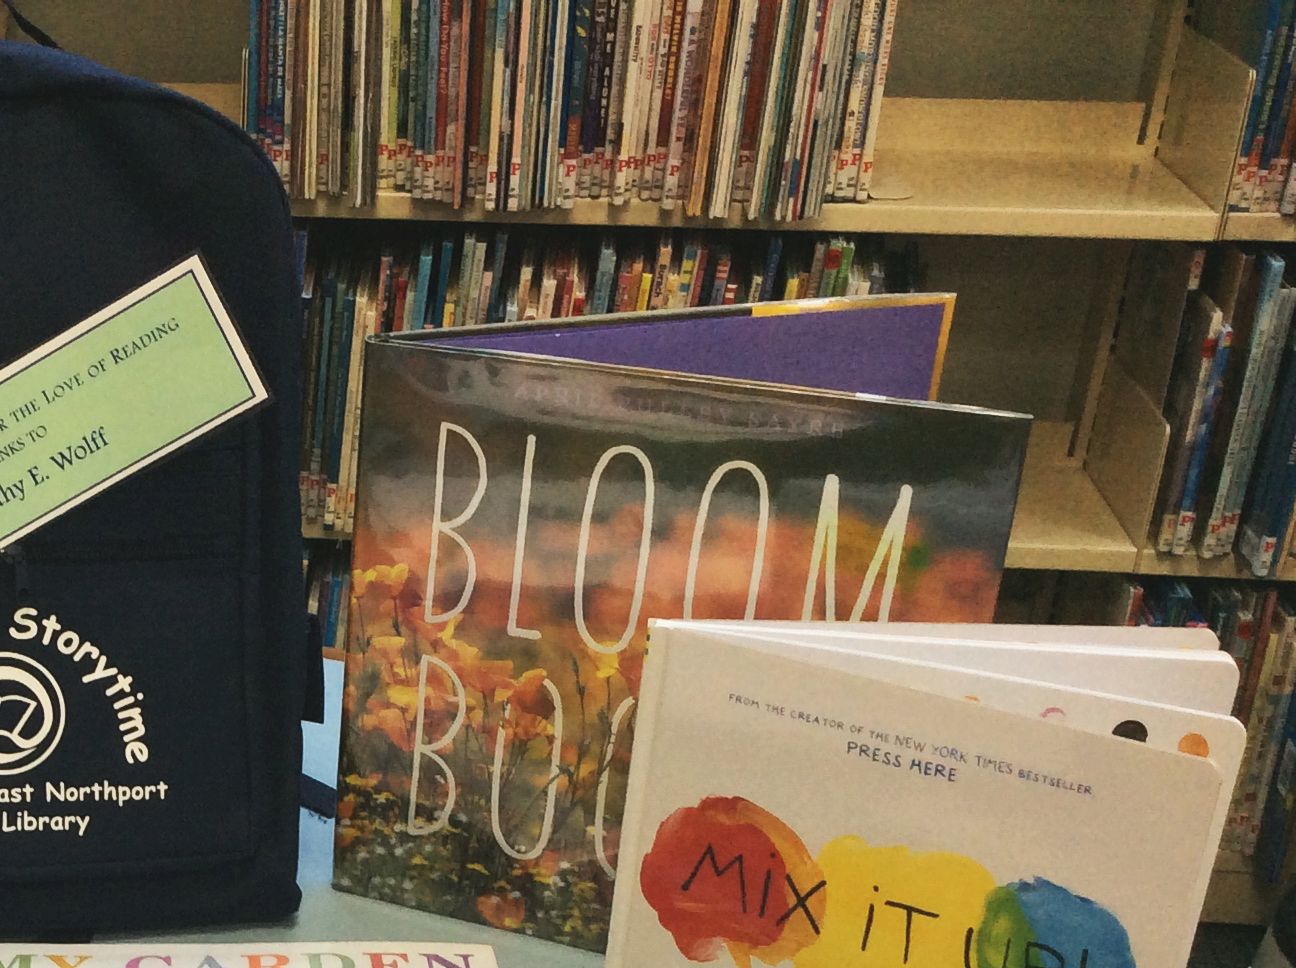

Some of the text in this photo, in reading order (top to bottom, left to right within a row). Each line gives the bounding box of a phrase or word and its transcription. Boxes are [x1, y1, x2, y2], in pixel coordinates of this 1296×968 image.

[671, 15, 681, 52] MELVIN
[27, 464, 51, 488] E.
[49, 426, 110, 474] Wolff
[8, 607, 149, 764] Storytime
[728, 692, 1093, 796] FROM THE CREATOR OF THE NEW YORK TIMES BESTSELLER
[846, 740, 957, 783] PRESS HERE
[45, 780, 168, 807] Northport
[2, 810, 90, 836] Library
